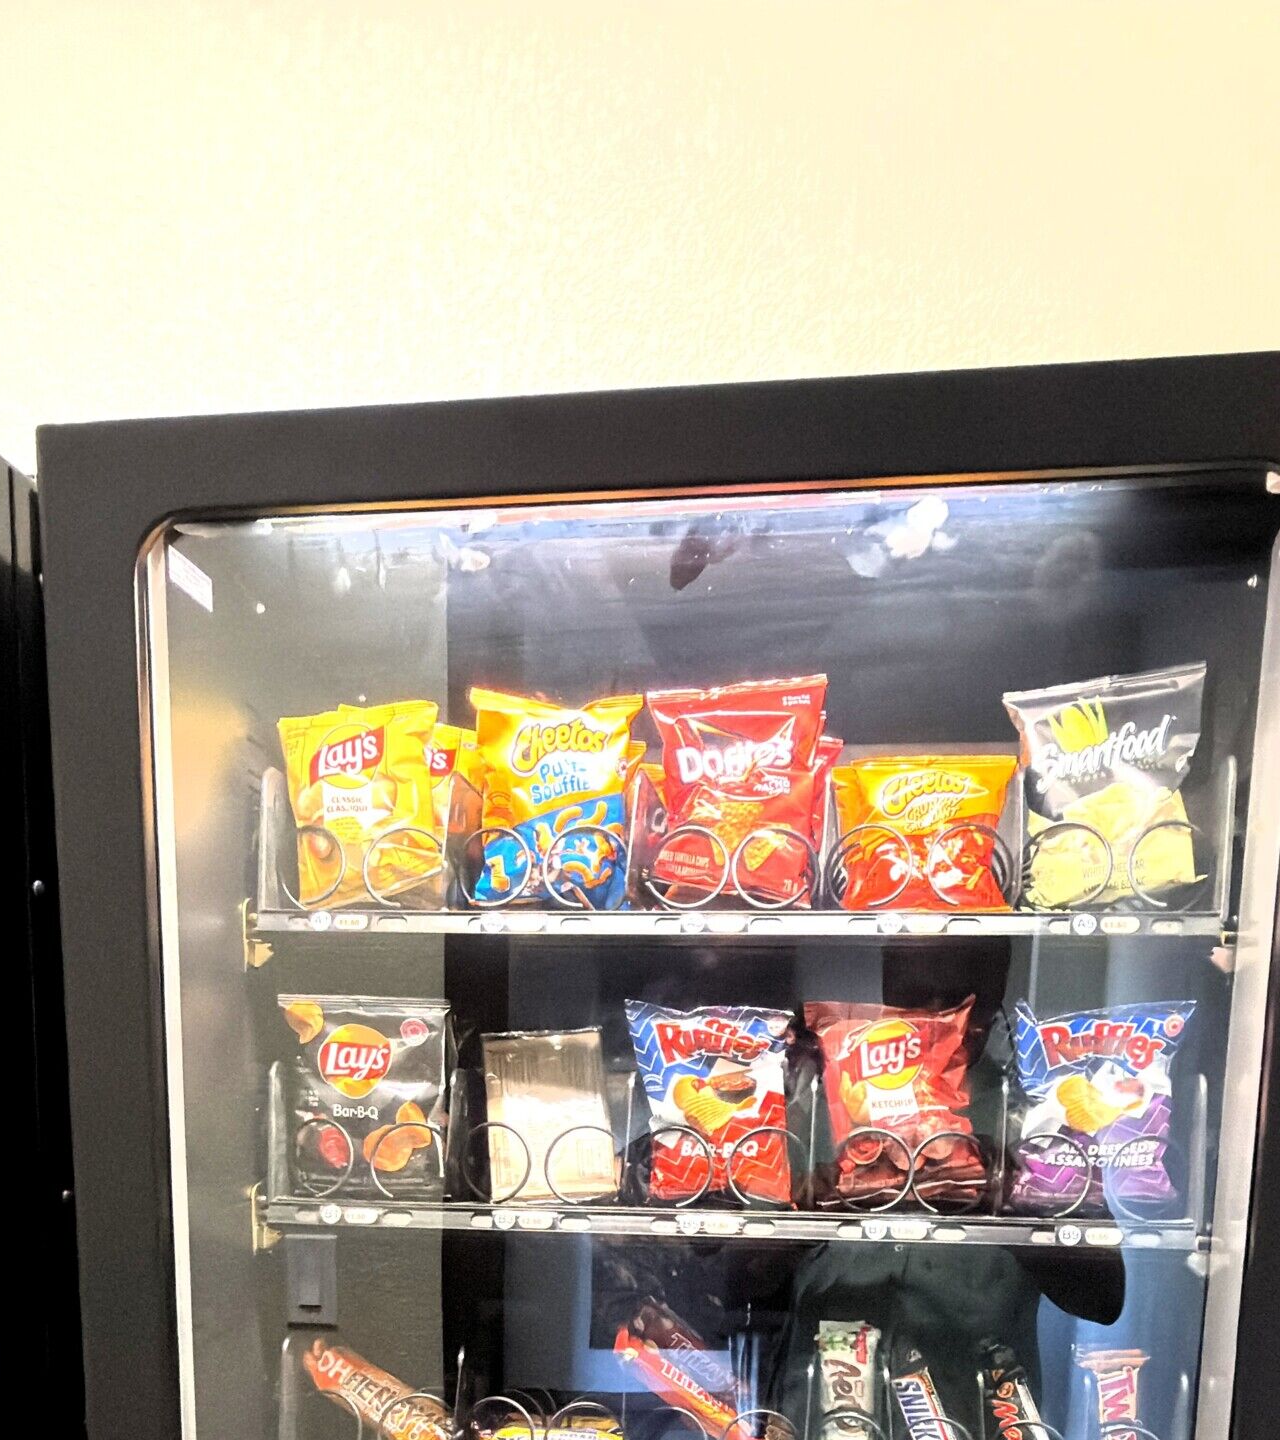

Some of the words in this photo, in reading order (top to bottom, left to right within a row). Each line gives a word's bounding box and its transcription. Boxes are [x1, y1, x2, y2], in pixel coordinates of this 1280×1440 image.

[317, 731, 380, 778] Lay's
[511, 717, 609, 774] Cheetos
[1036, 713, 1172, 795] Smartfood
[882, 770, 970, 817] Cheetos
[324, 1042, 389, 1081] Lay's
[859, 1032, 922, 1077] Lay's
[1039, 1022, 1166, 1070] Ruffles
